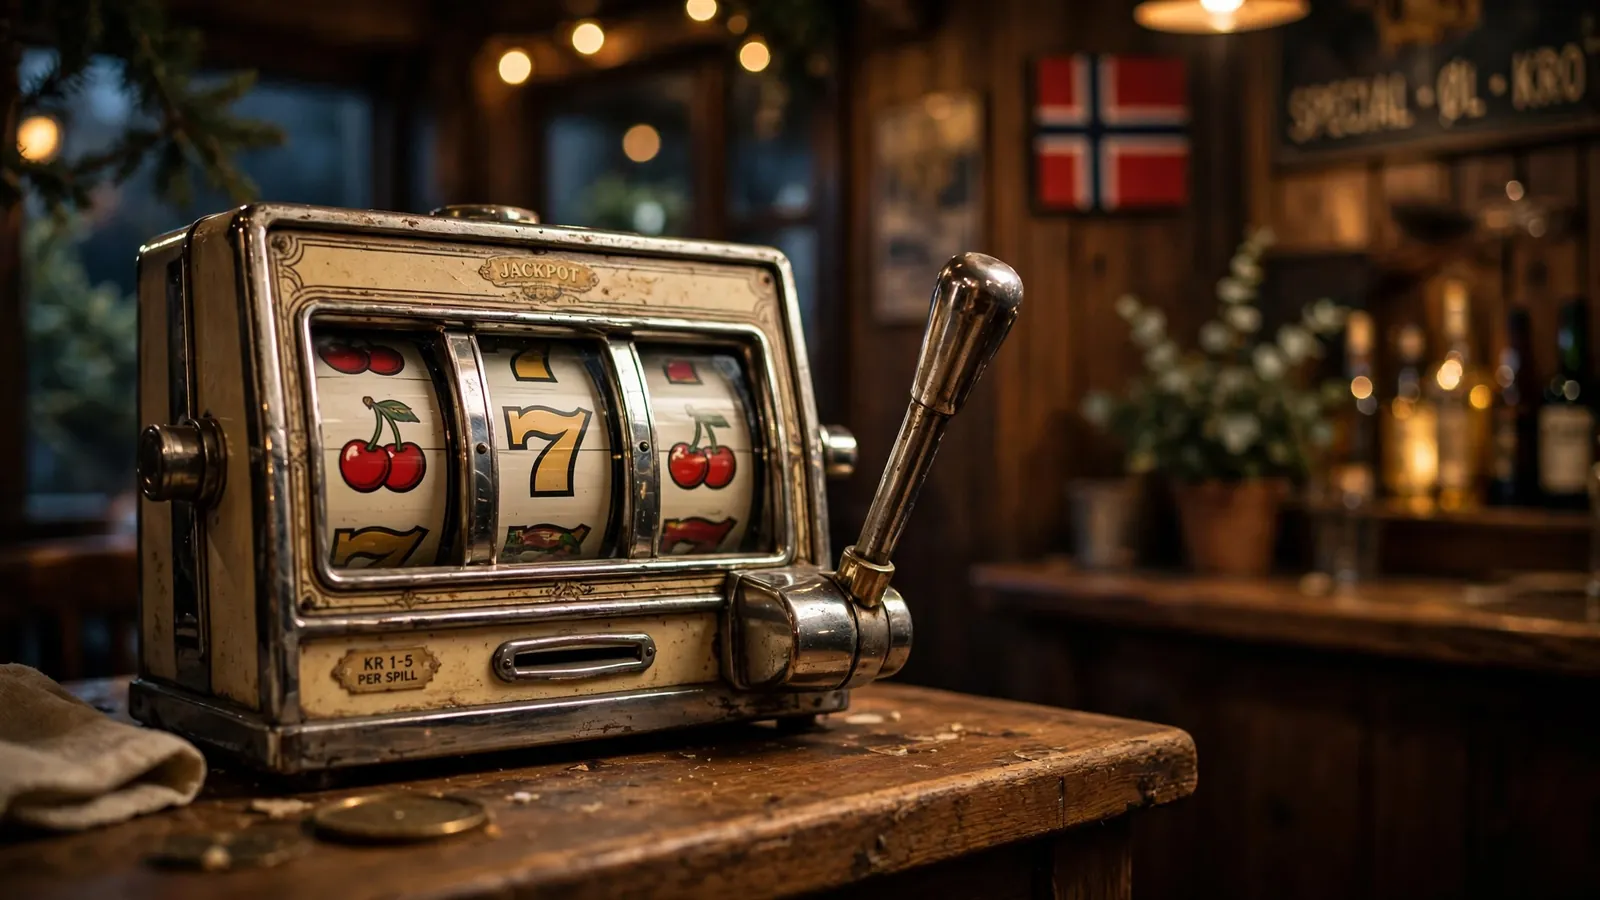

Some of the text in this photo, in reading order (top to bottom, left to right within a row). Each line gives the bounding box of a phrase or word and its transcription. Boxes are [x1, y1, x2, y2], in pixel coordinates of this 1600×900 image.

[1289, 73, 1413, 142] SPECIAL
[1512, 43, 1586, 109] KRO
[500, 262, 580, 282] JACKPOT
[502, 405, 592, 497] 7
[364, 654, 413, 671] KR 1-5
[358, 670, 417, 685] PER SPILL
